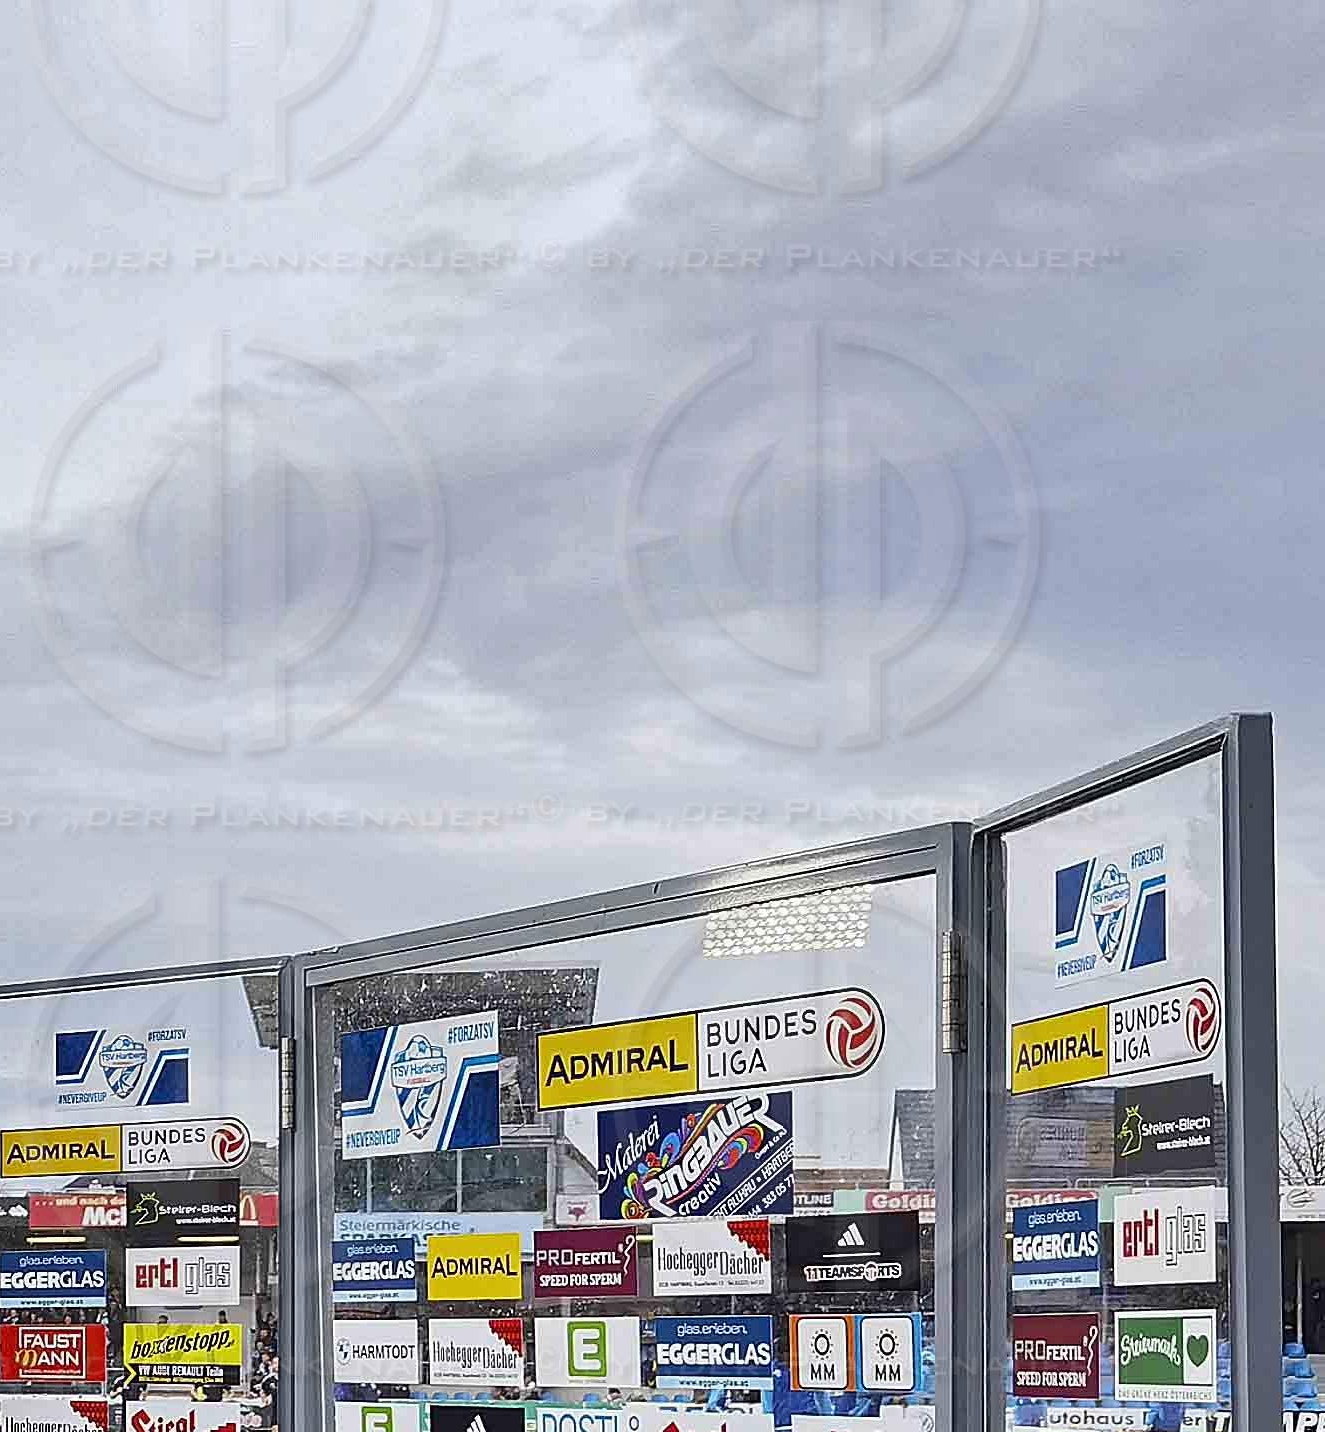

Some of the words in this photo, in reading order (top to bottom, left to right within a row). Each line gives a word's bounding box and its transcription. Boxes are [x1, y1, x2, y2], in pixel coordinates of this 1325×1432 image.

[706, 1009, 817, 1047] BUNDES
[1114, 999, 1181, 1034] BUNDES
[448, 1022, 495, 1043] #FORZATSV
[1016, 1028, 1104, 1073] ADMIRAL
[1114, 1036, 1151, 1063] LIGA
[393, 1065, 410, 1078] TSV
[410, 1062, 446, 1077] Hartberg
[545, 1039, 689, 1087] ADMIRAL
[707, 1048, 767, 1078] LIGA
[127, 1128, 206, 1146] BUNDES
[346, 1127, 402, 1148] #NEVERGIVEUP
[6, 1140, 116, 1165] ADMIRAL
[127, 1147, 171, 1166] LIGA
[598, 1114, 661, 1193] Malerei
[1013, 1231, 1099, 1262] EGGERGLAS
[1122, 1208, 1159, 1258] ertl
[1165, 1206, 1206, 1267] glas
[135, 1258, 179, 1289] ertl
[184, 1257, 231, 1295] glas
[333, 1260, 415, 1280] EGGERGLAS
[432, 1254, 518, 1278] ADMIRAL
[0, 1270, 105, 1289] EGGERGLAS
[539, 1274, 568, 1288] SPEED
[569, 1274, 589, 1287] FOR
[590, 1273, 622, 1287] SPERM
[22, 1333, 81, 1349] FAUST
[352, 1344, 415, 1359] HARMTODT
[657, 1343, 771, 1366] EGGERGLAS
[1016, 1372, 1041, 1386] SPEED
[1041, 1372, 1058, 1386] FOR
[1058, 1371, 1087, 1387] SPERM
